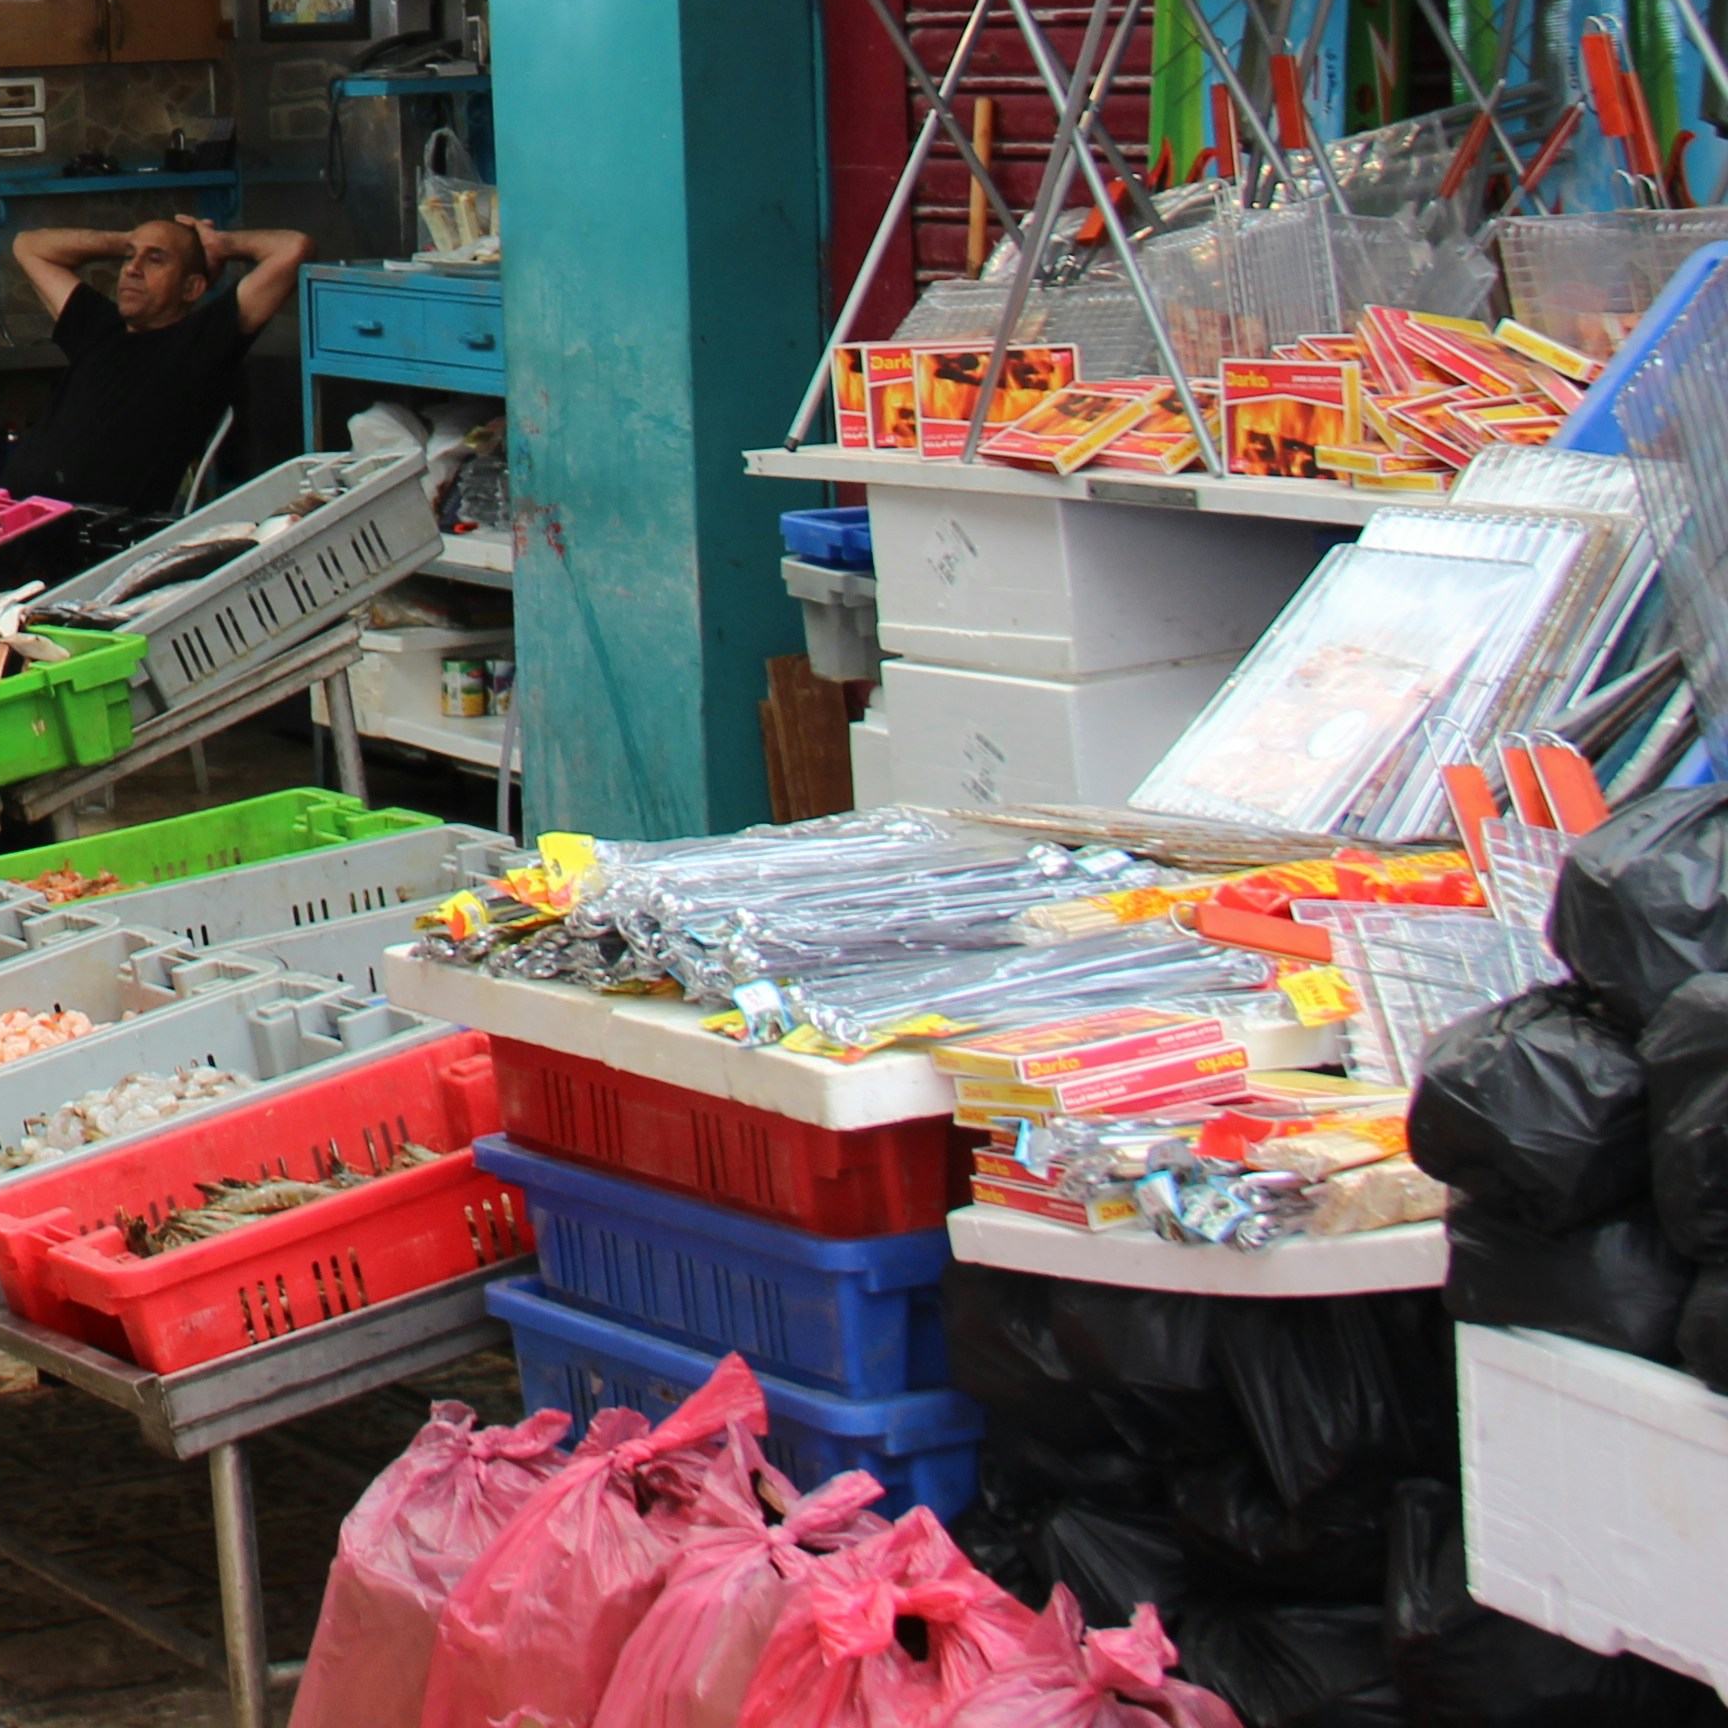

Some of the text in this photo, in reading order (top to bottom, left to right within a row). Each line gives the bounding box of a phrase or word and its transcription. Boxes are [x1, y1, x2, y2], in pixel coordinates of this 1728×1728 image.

[870, 355, 913, 370] Dark
[1227, 371, 1270, 388] Darko
[1027, 1057, 1081, 1077] Darko
[1101, 1196, 1135, 1220] Dark
